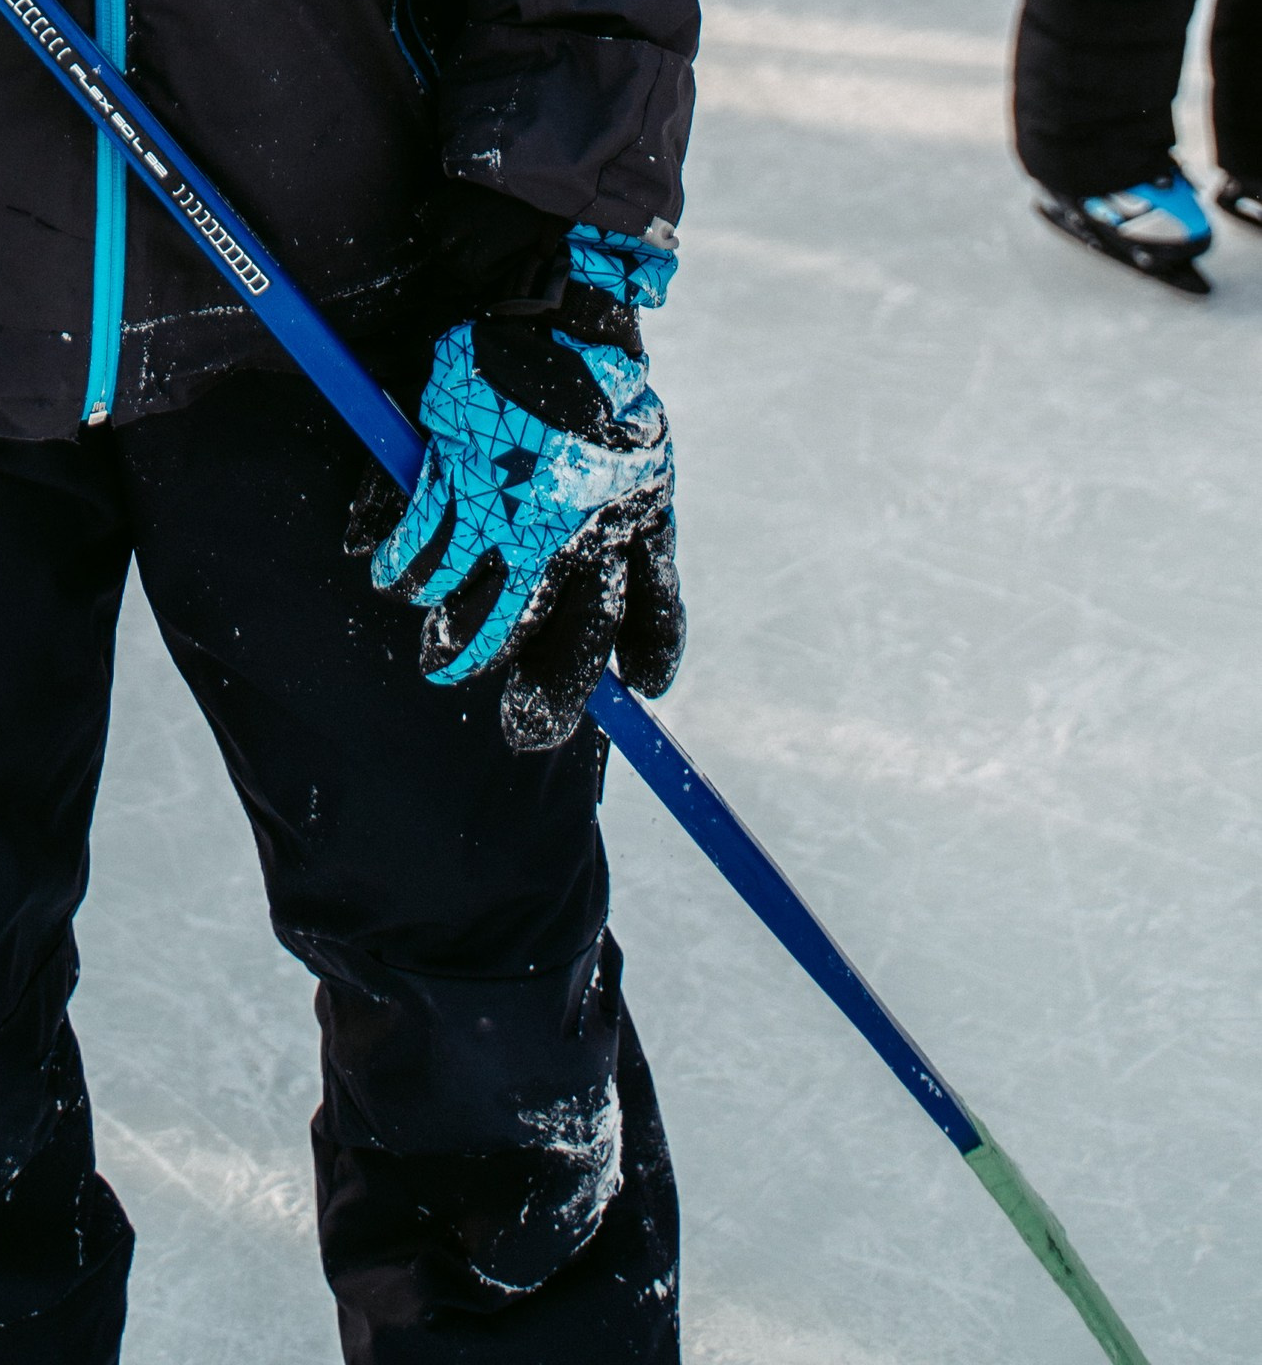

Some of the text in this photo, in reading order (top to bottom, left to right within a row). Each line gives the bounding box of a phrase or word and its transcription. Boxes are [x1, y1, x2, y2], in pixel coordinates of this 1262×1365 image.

[69, 63, 114, 113] FLEX
[132, 136, 144, 153] L
[144, 151, 169, 179] 92
